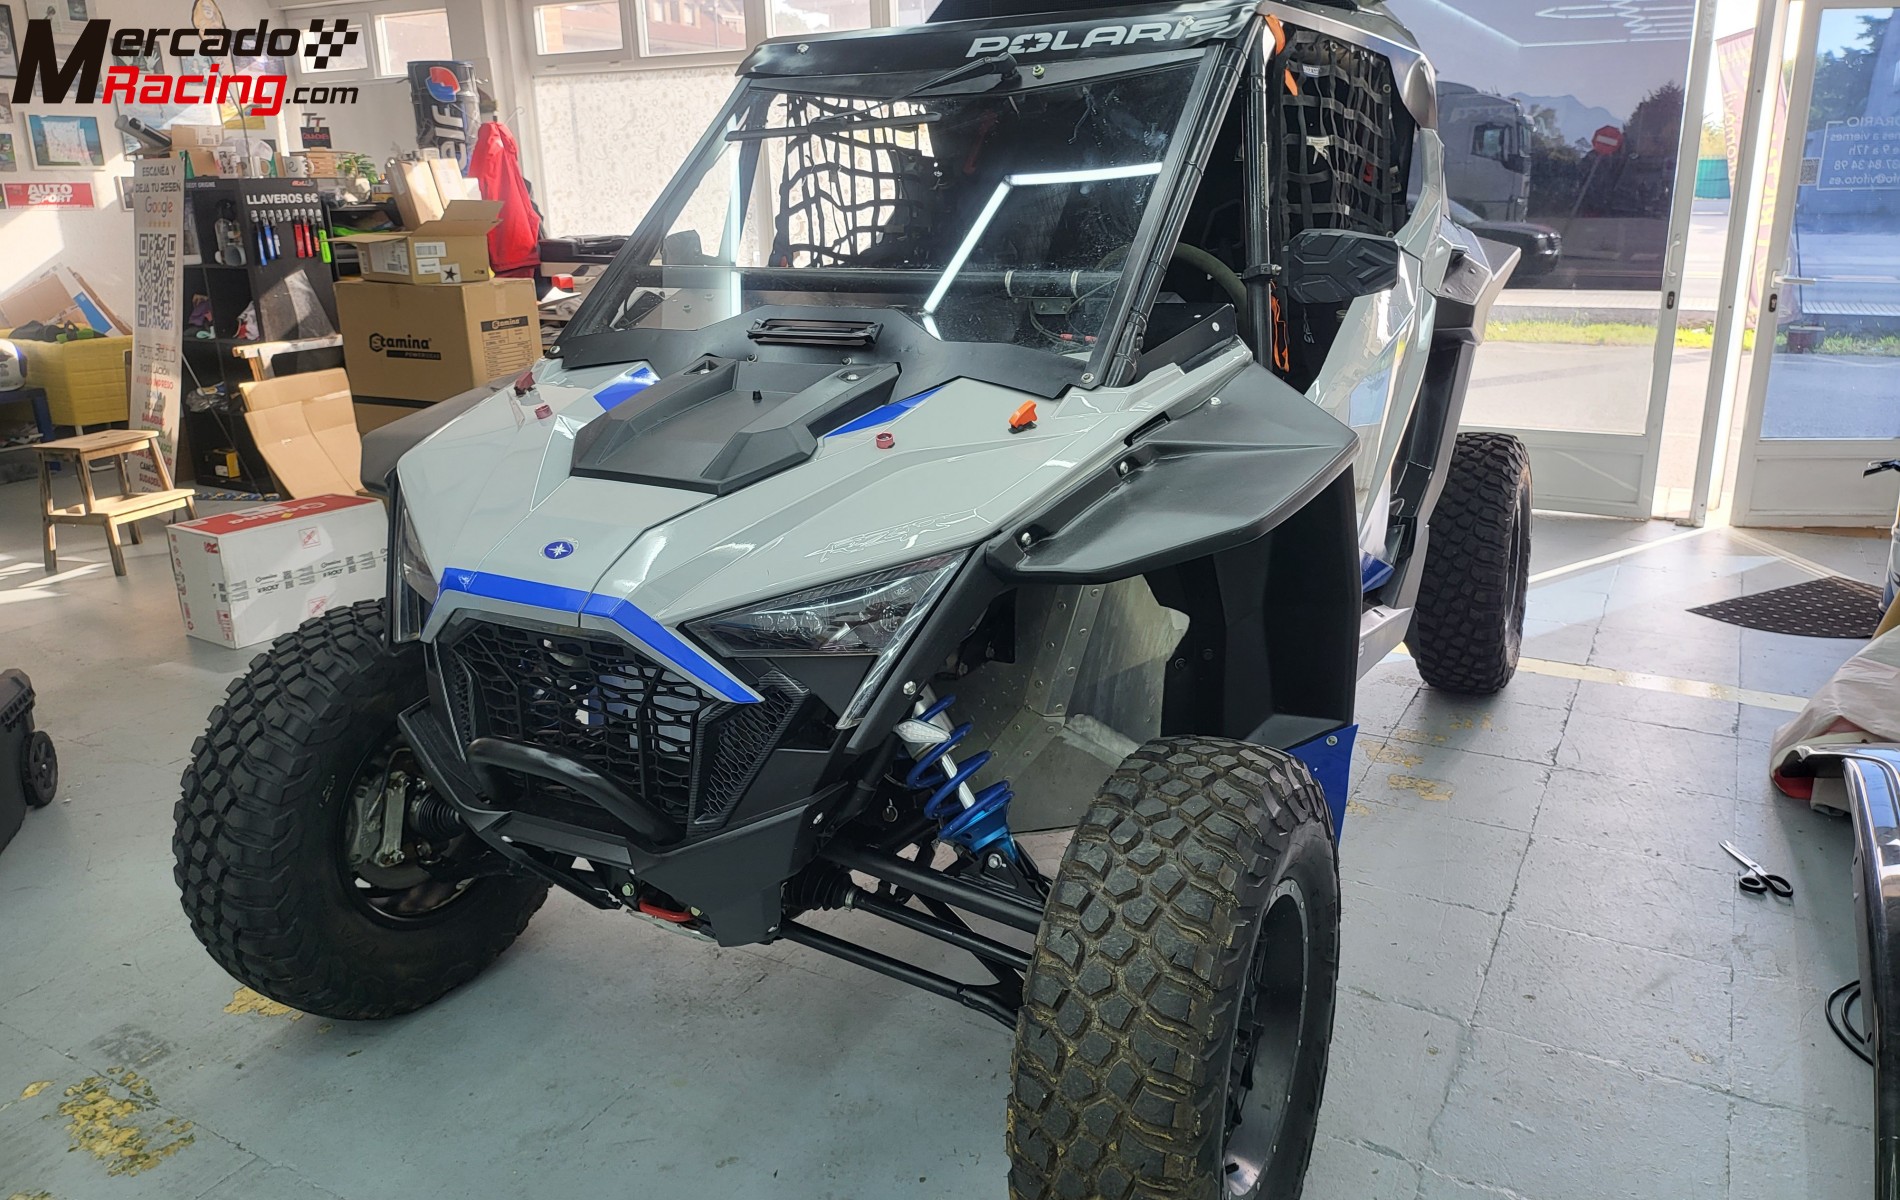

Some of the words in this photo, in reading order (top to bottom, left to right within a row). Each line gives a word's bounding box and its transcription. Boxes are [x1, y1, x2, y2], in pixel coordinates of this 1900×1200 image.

[965, 15, 1232, 58] POLARIS
[171, 165, 177, 175] Y
[28, 184, 73, 196] AUTO
[135, 183, 150, 193] DEJA
[151, 183, 159, 193] TU
[28, 194, 73, 204] SPORT
[246, 193, 303, 205] LLAVEROS
[304, 193, 319, 203] 6€
[145, 196, 173, 217] Google
[369, 333, 430, 352] Stamina
